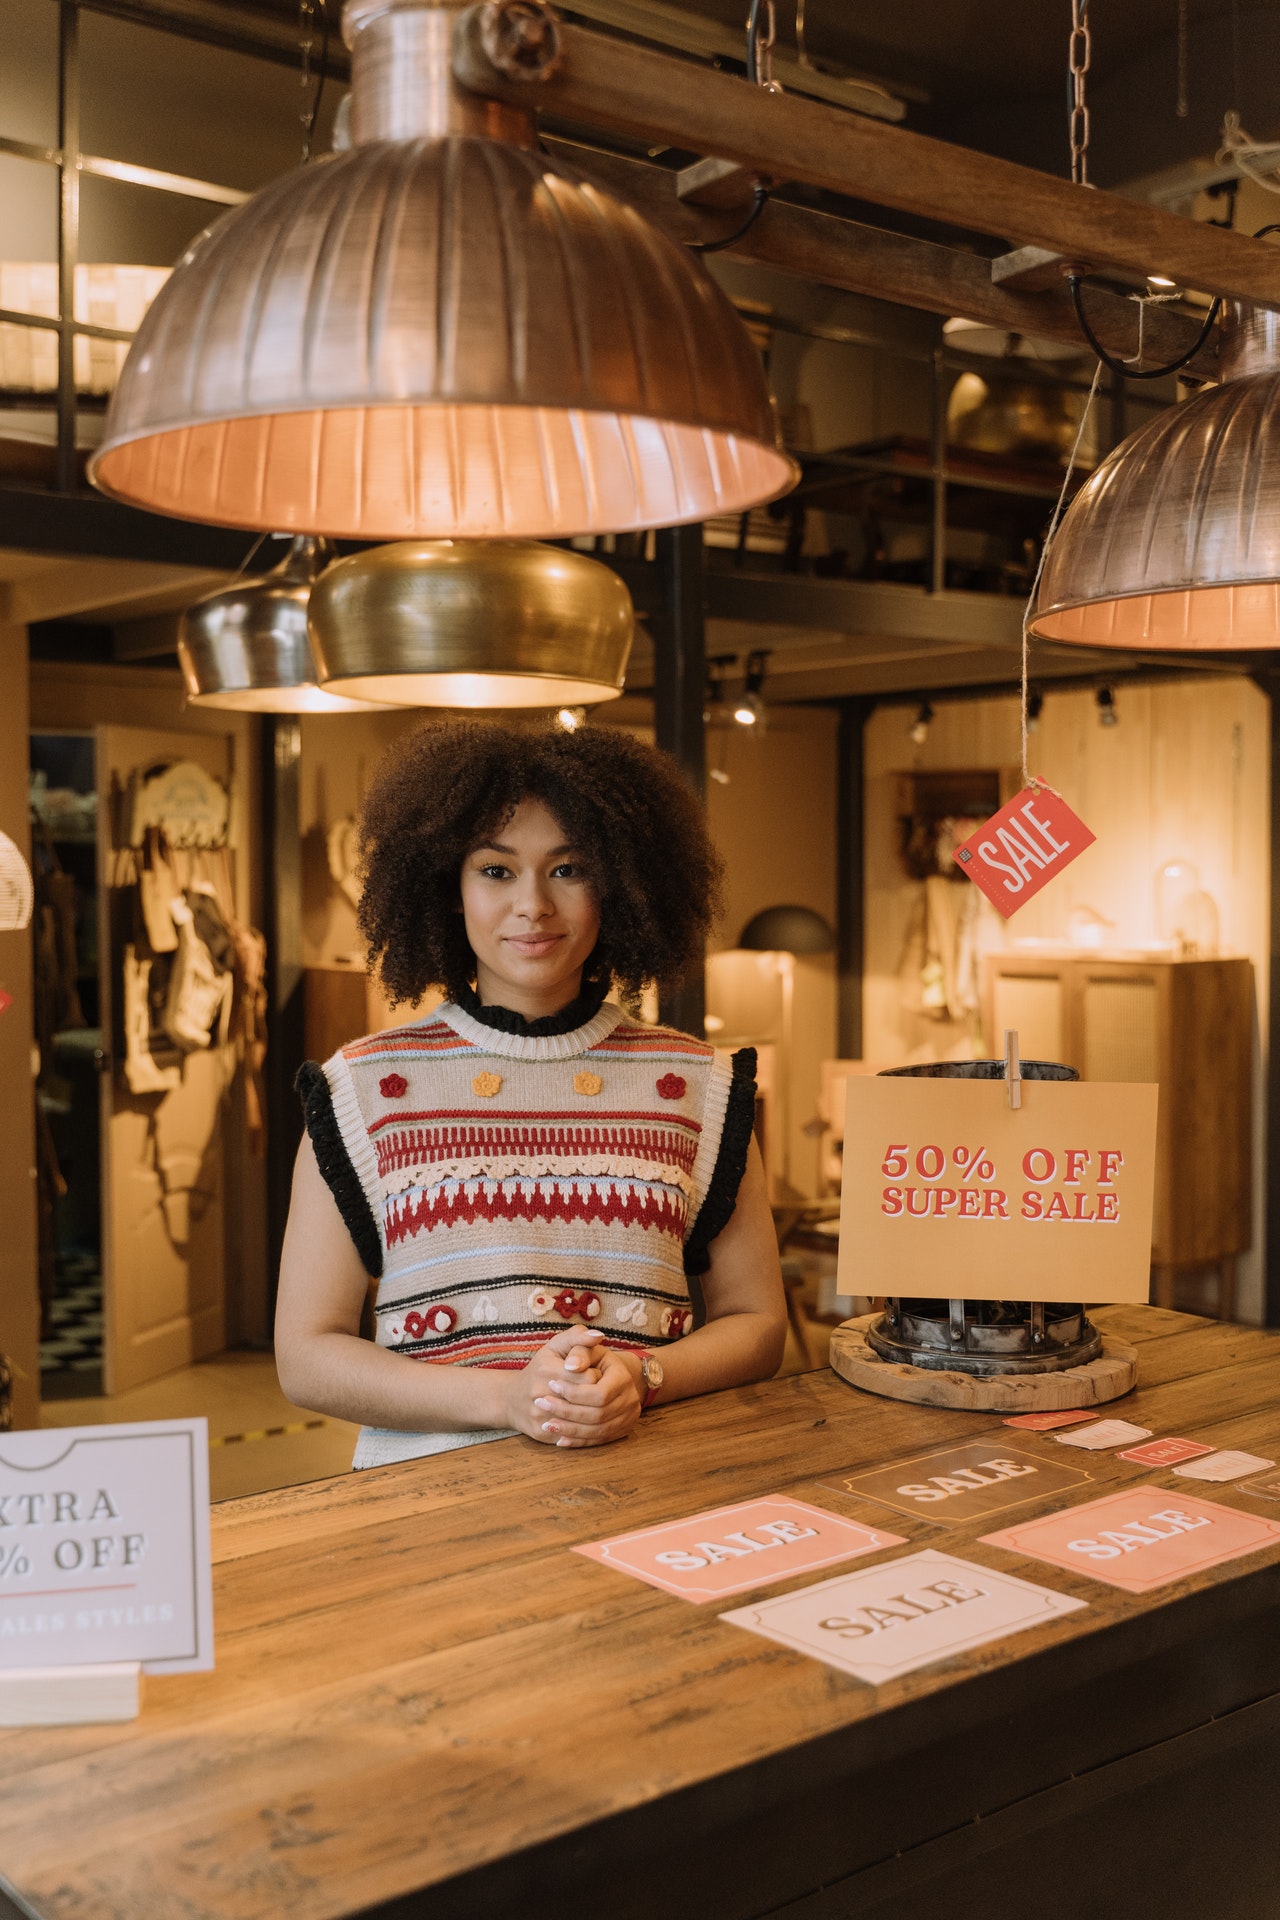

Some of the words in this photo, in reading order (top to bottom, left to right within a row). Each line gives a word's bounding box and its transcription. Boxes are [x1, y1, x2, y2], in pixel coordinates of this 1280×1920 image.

[977, 800, 1071, 893] SALE
[881, 1144, 996, 1183] 50%
[1022, 1147, 1125, 1187] OFF
[881, 1187, 1011, 1221] SUPER
[1020, 1190, 1121, 1224] SALE
[1148, 1445, 1188, 1459] SALE
[896, 1457, 1040, 1503] SALE
[54, 1534, 146, 1571] OFF
[655, 1519, 822, 1572] SALE
[1066, 1509, 1215, 1560] SALE
[74, 1603, 174, 1630] STYLES
[817, 1579, 987, 1639] SALE
